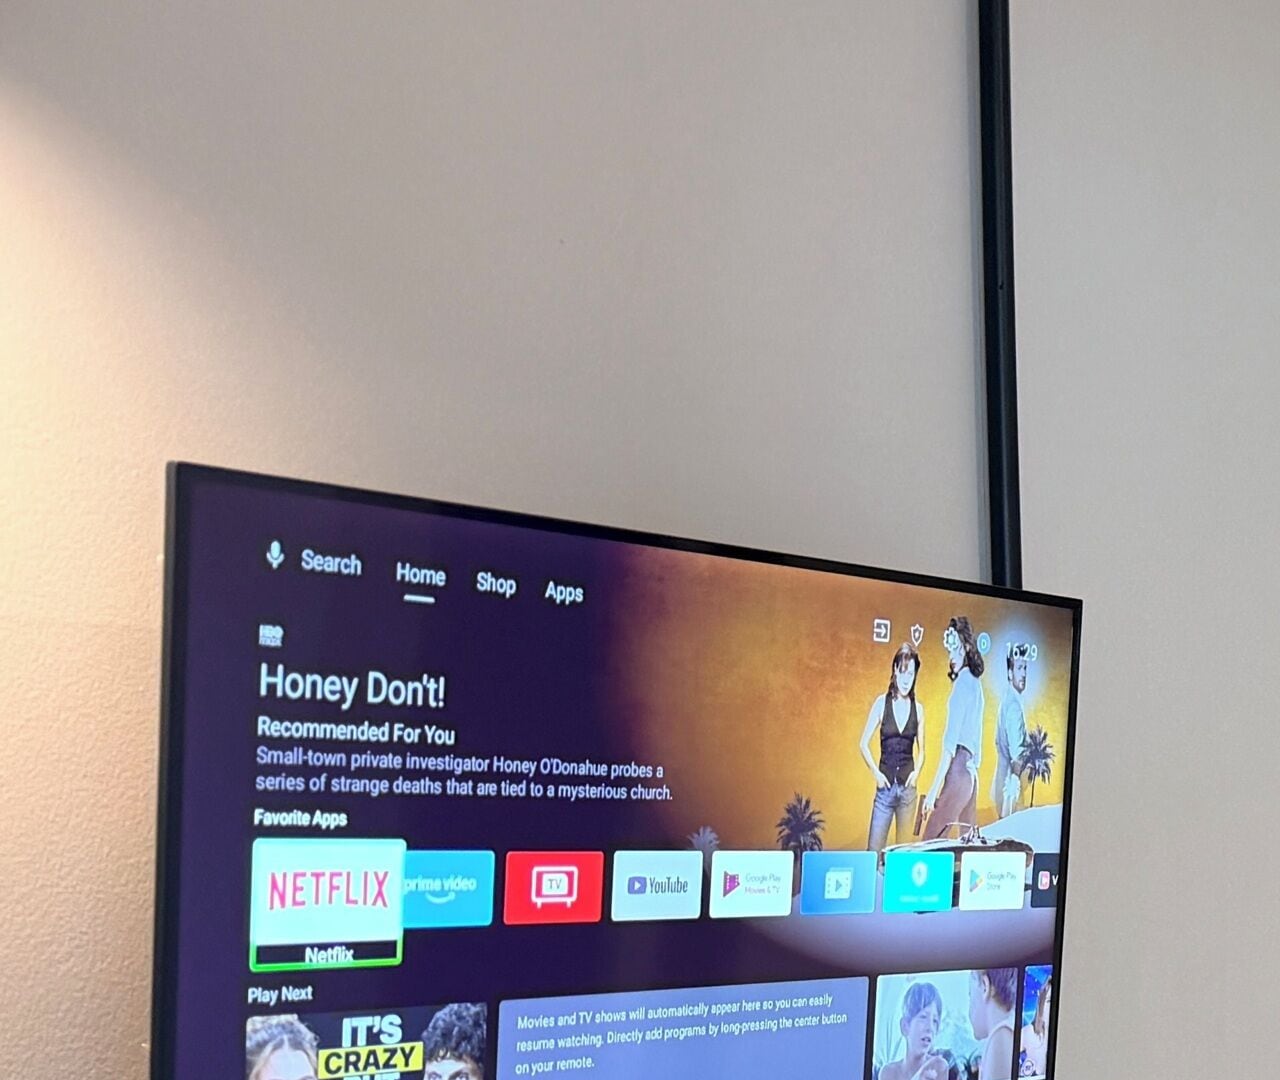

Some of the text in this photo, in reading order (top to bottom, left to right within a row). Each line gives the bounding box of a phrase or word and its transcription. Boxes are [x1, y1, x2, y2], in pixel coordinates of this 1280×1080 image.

[301, 549, 362, 576] Search
[396, 561, 446, 587] Home
[476, 572, 517, 598] Shop
[545, 580, 584, 604] Apps
[1006, 642, 1038, 662] 16:29
[260, 662, 445, 710] Honey Don't!
[257, 716, 456, 745] Recommended For You
[256, 746, 664, 782] Small-town private investigator Honey O'Donahue probes a
[256, 774, 673, 802] series of strange deaths that are tied to a mysterious church.
[254, 809, 348, 828] Favorite Apps
[268, 870, 389, 910] NETFLIX
[443, 874, 478, 892] video
[547, 878, 563, 890] TV
[649, 876, 688, 894] YouTube
[304, 946, 354, 964] Netflix
[248, 986, 314, 1006] Play Next
[518, 993, 833, 1030] Movies and TV shows will automatically appear here so you can easily
[342, 1014, 402, 1048] IT'S
[516, 1012, 847, 1052] resume watching. Directly add programs by long-pressing the center button
[324, 1046, 416, 1076] CRAZY
[516, 1056, 594, 1076] on your remote.
